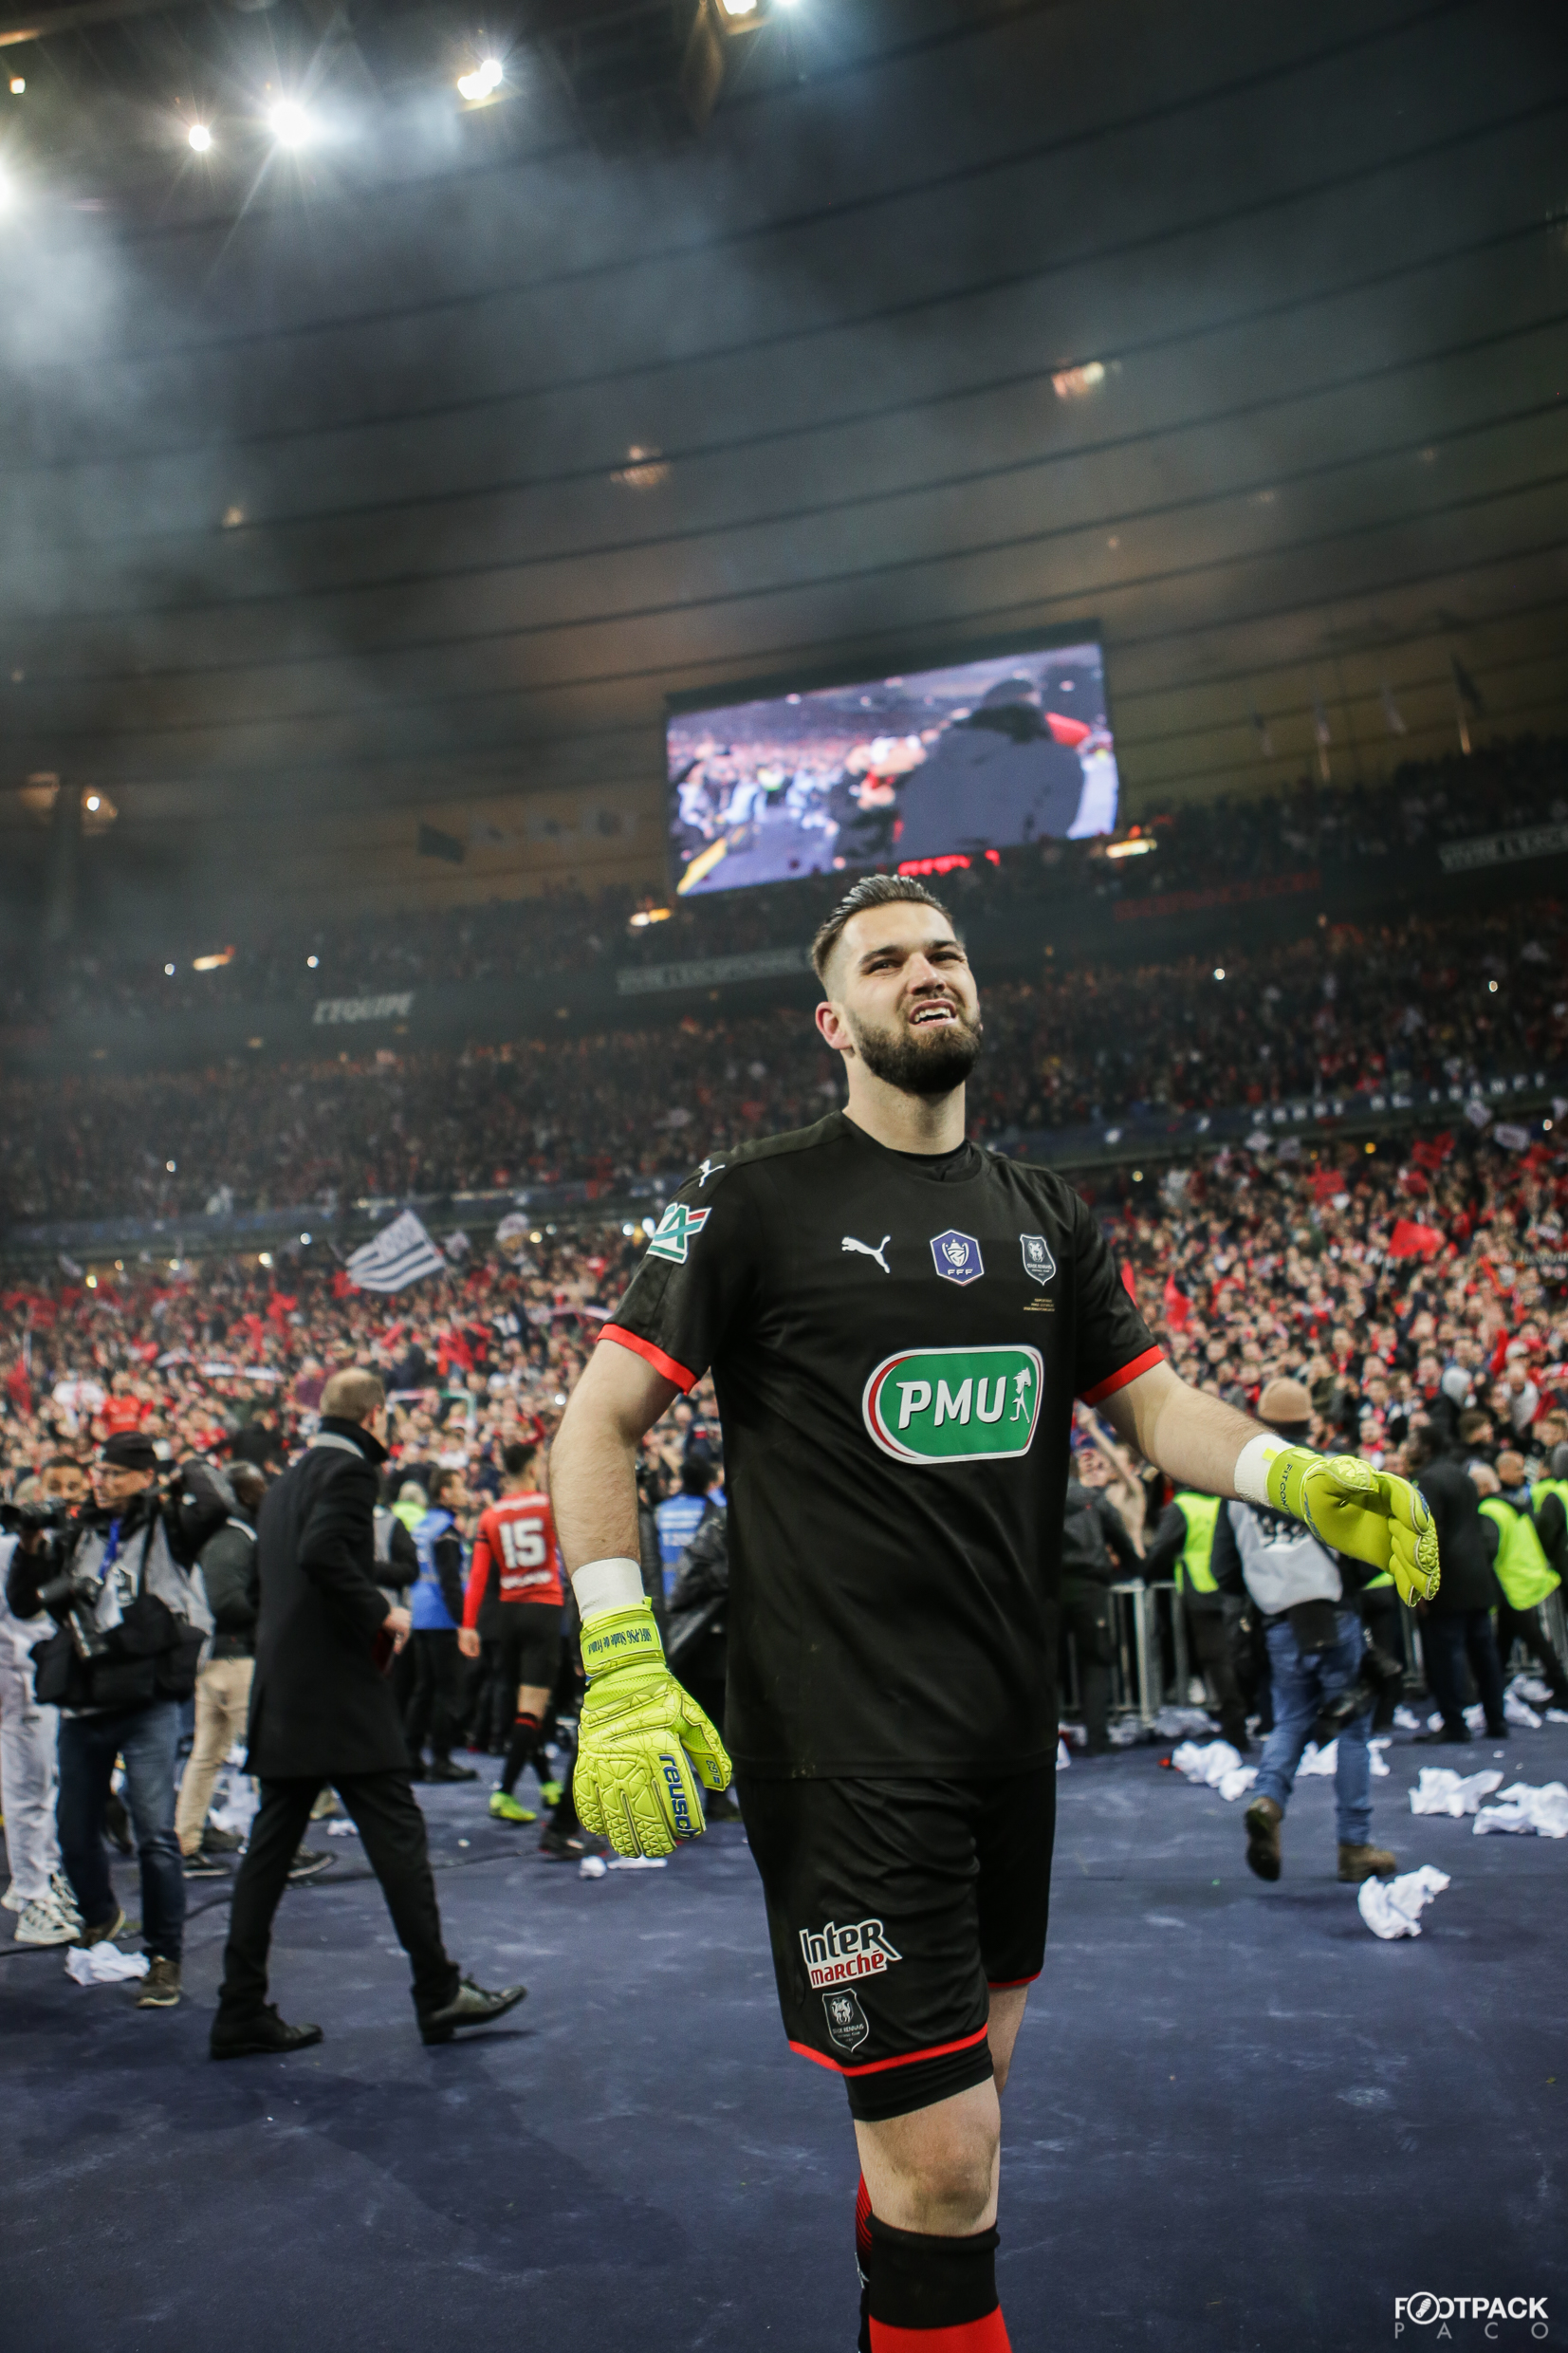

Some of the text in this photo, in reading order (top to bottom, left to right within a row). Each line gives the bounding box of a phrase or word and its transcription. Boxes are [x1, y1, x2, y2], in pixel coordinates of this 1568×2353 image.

[895, 1376, 1007, 1430] PMU
[499, 1517, 546, 1569] 15
[658, 1753, 700, 1838] reusch
